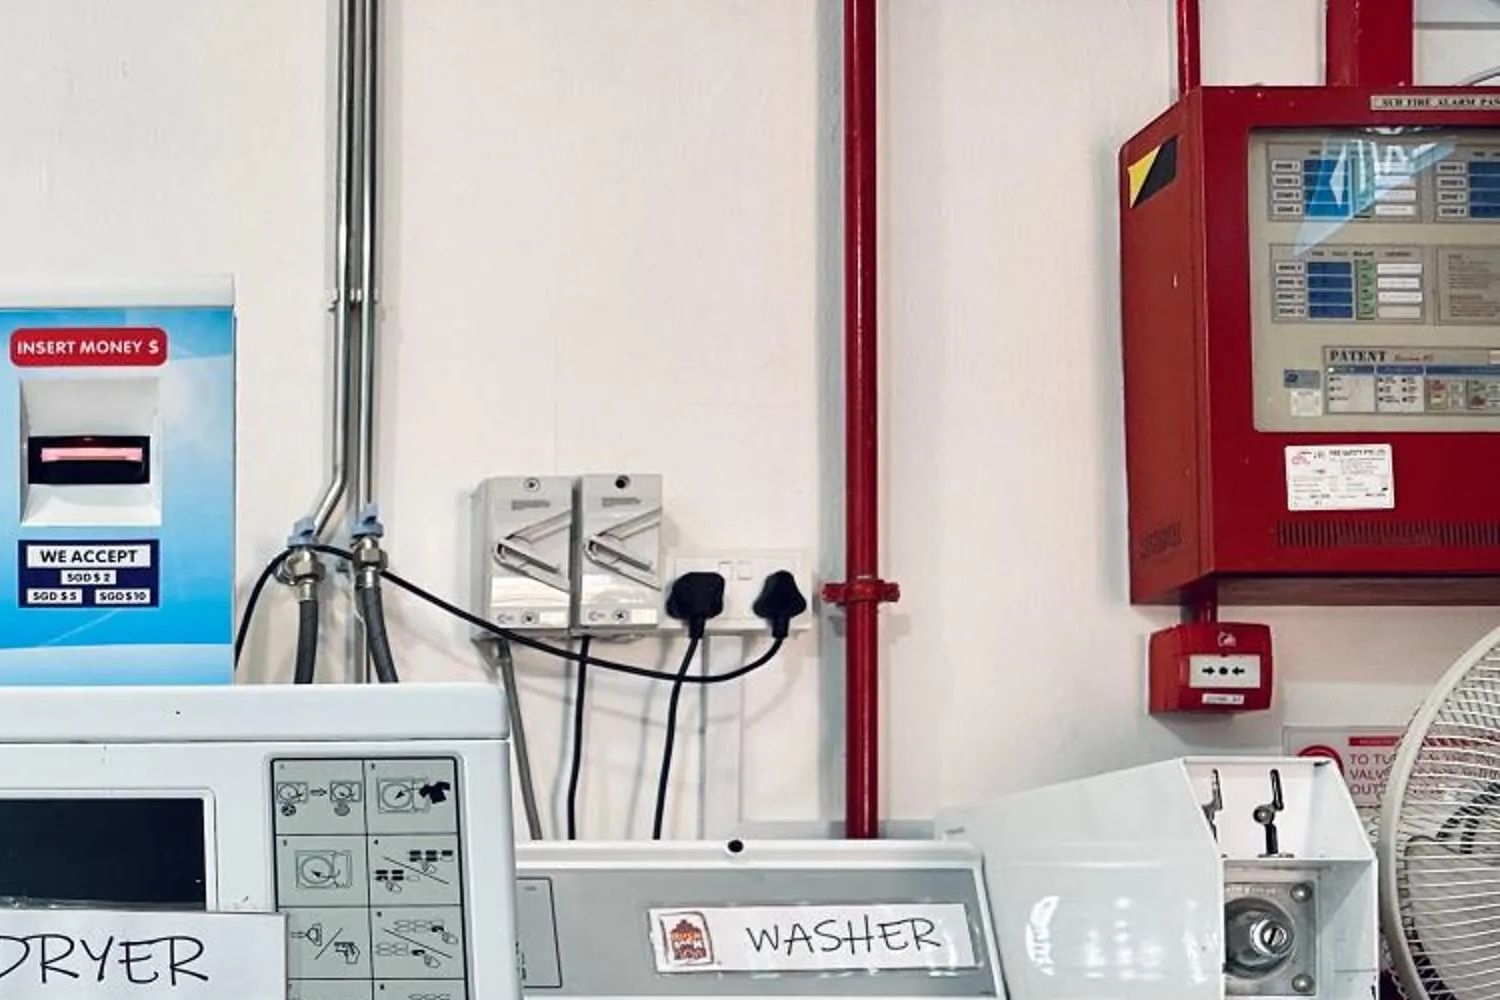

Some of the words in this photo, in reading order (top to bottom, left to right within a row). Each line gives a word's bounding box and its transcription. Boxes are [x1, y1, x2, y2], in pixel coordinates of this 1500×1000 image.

[17, 340, 77, 355] INSERT
[79, 340, 143, 355] MONEY
[148, 339, 160, 356] $
[1329, 350, 1387, 362] PATENT
[40, 549, 67, 563] WE
[71, 549, 139, 563] ACCEPT
[67, 572, 91, 583] SGD
[33, 591, 59, 601] SGD
[1349, 753, 1369, 765] TO
[744, 913, 942, 957] WASHER
